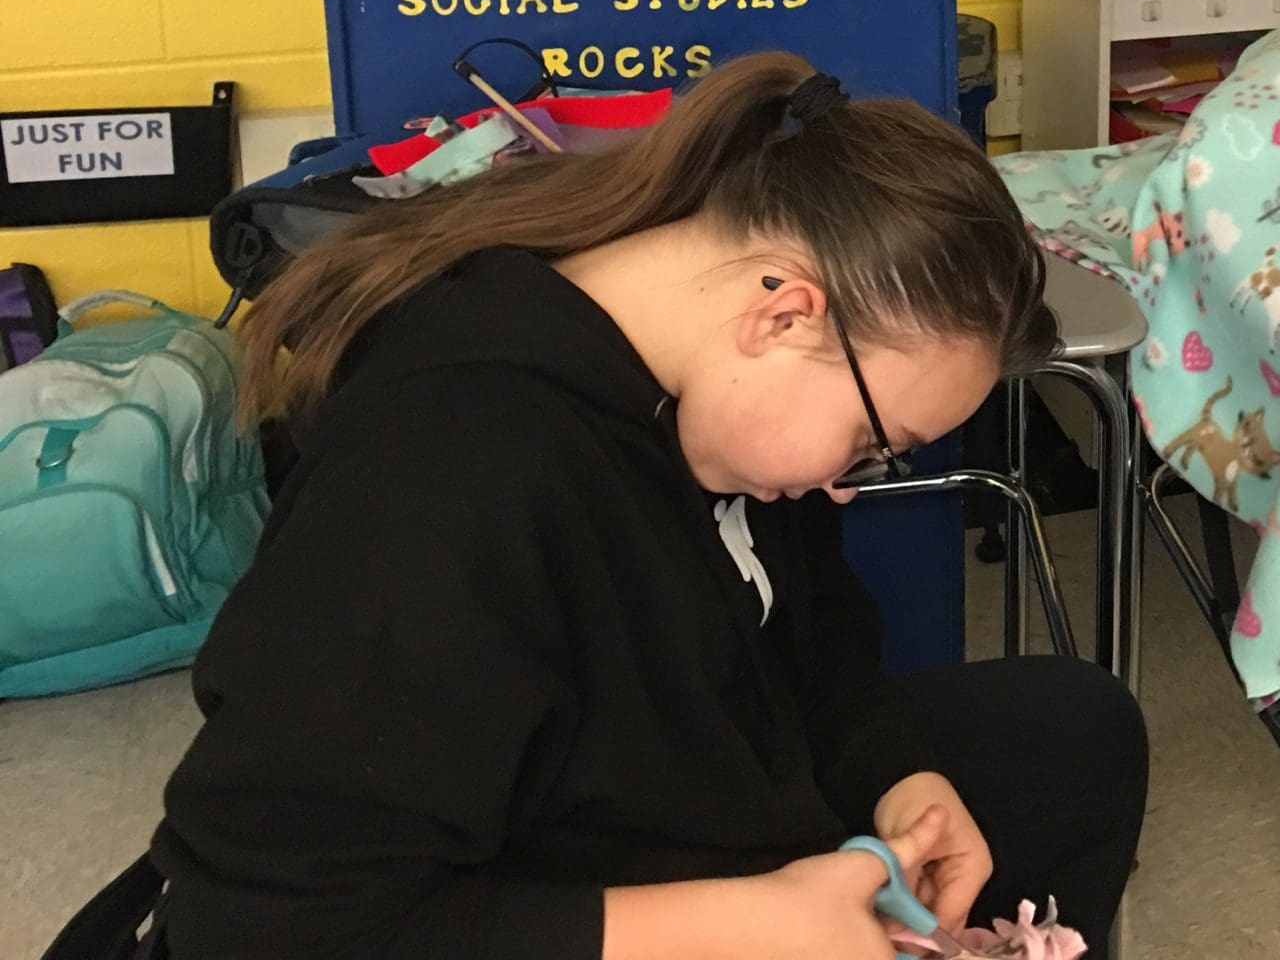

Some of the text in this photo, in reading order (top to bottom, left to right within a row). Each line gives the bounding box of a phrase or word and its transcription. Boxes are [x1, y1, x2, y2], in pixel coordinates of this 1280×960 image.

[541, 45, 713, 79] ROCKS
[10, 120, 164, 145] JUST FOR
[58, 152, 123, 174] FUN
